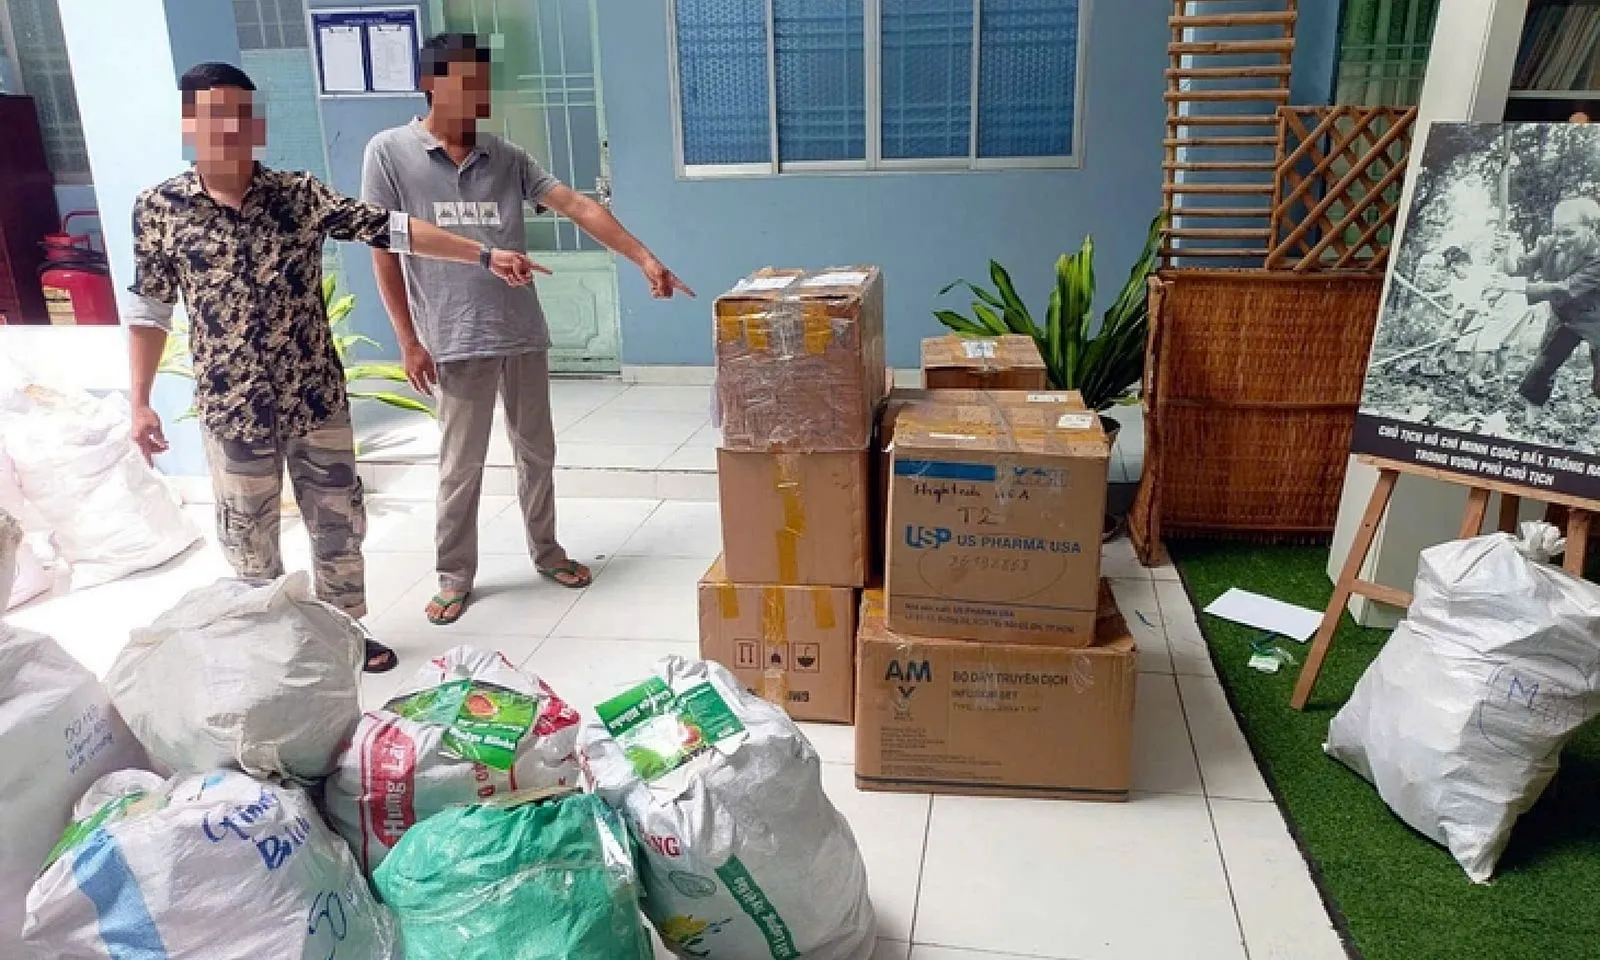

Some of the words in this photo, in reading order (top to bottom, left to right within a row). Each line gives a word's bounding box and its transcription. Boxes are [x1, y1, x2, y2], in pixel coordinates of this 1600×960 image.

[957, 535, 977, 548] US
[981, 536, 1046, 551] PHARMA
[1049, 541, 1082, 554] USA
